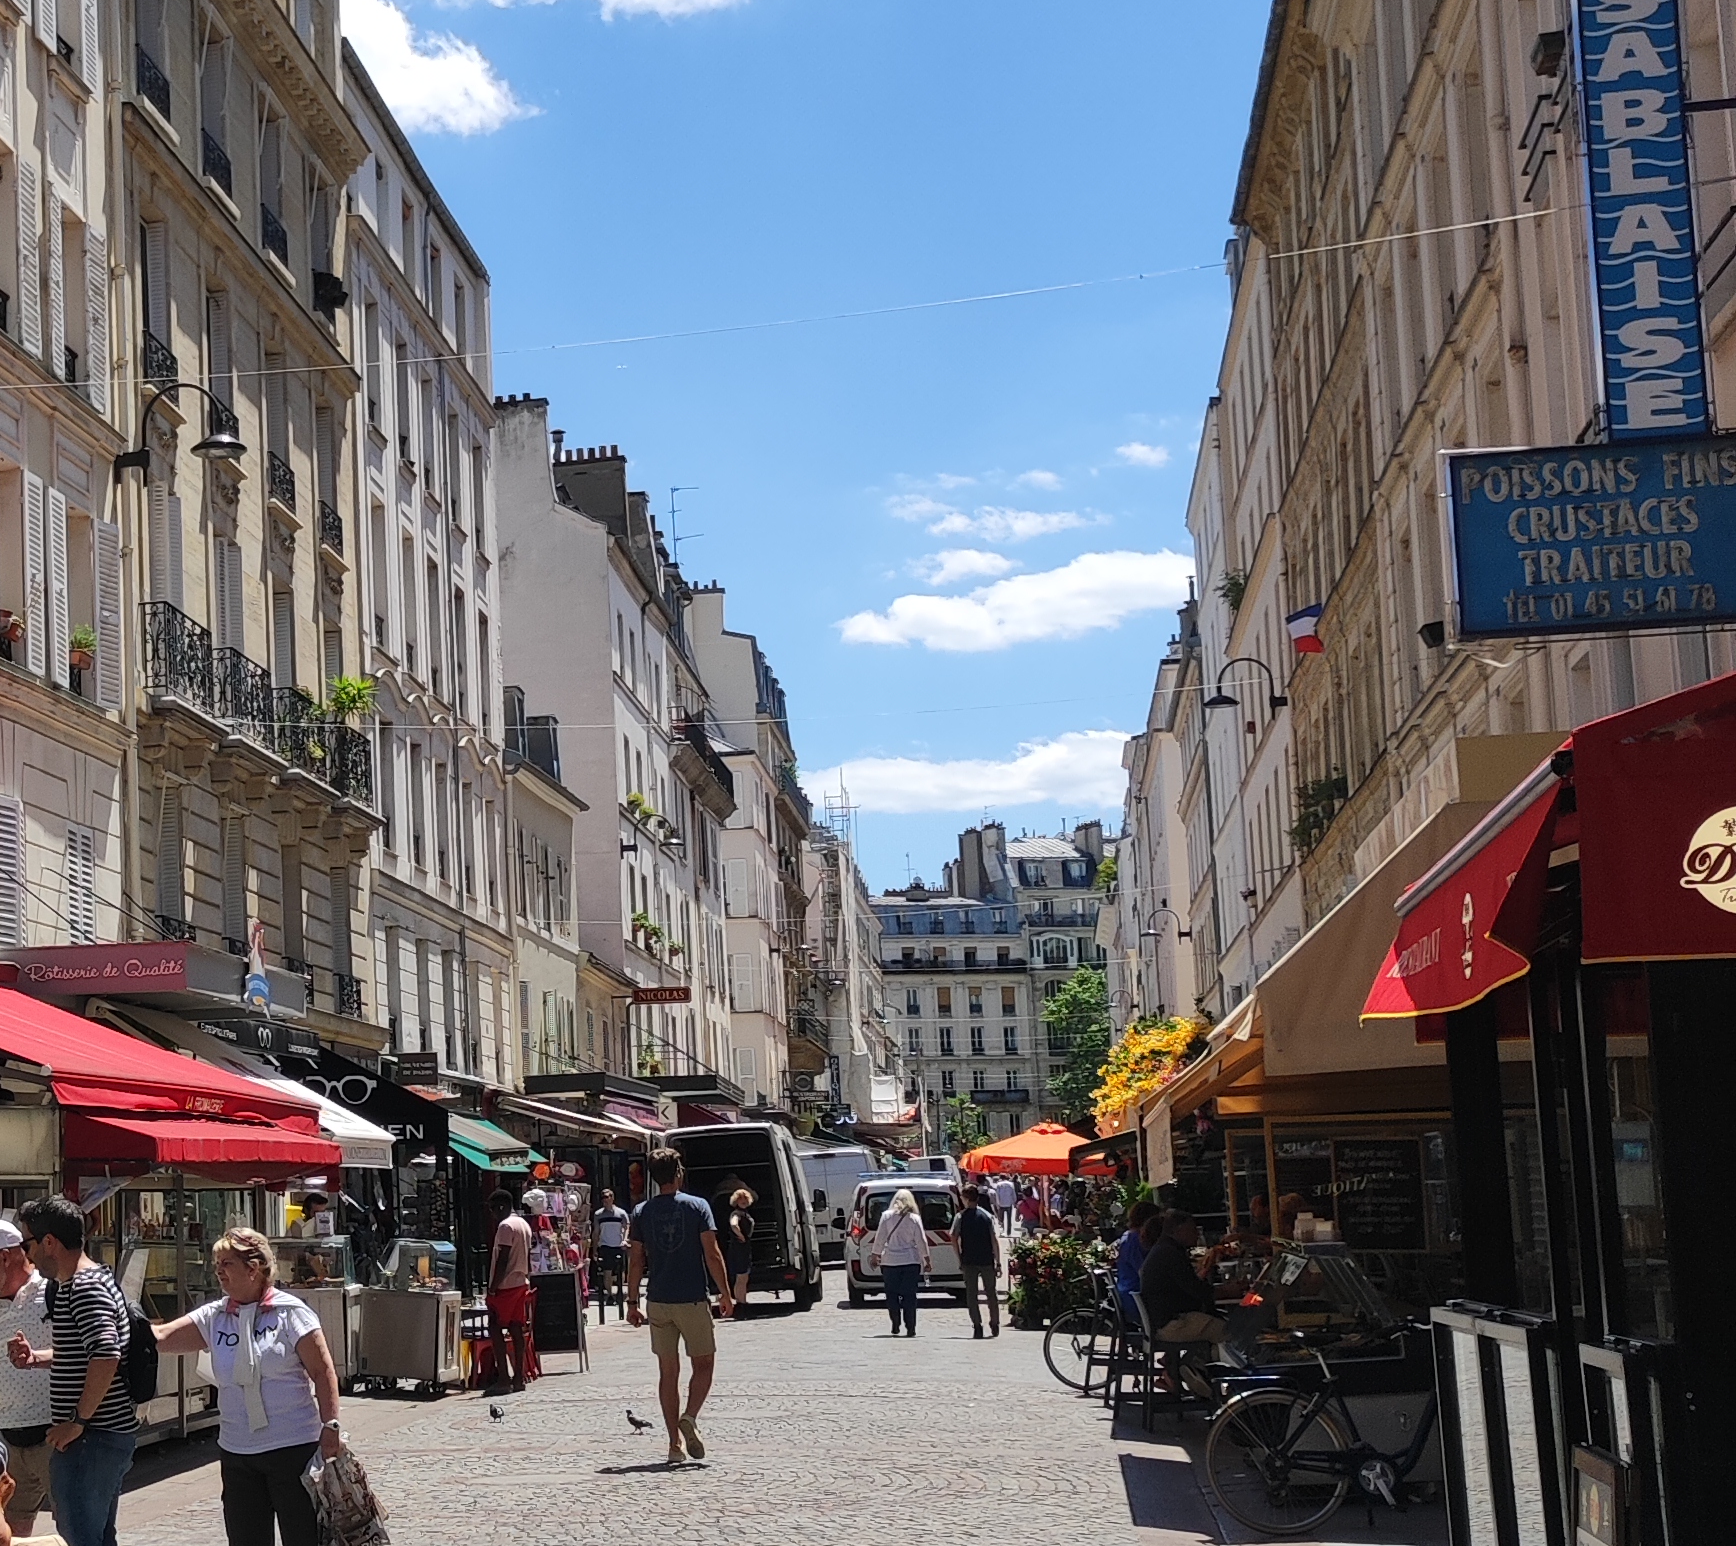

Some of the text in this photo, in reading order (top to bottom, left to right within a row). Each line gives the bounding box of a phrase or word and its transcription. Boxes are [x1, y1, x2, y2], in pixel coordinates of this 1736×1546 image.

[1460, 449, 1736, 505] POISSONS FINS
[1507, 496, 1700, 545] CRUSTACES
[1518, 539, 1695, 587] TRAITEUR
[1550, 592, 1573, 621] 01
[1584, 590, 1610, 618] 45
[1623, 587, 1646, 616] 51
[1655, 585, 1678, 613] 61
[1689, 583, 1717, 612] 78
[24, 959, 184, 982] Rôtisserie de Qualité
[637, 989, 687, 1002] NICOLAS
[216, 1324, 278, 1347] TOMY
